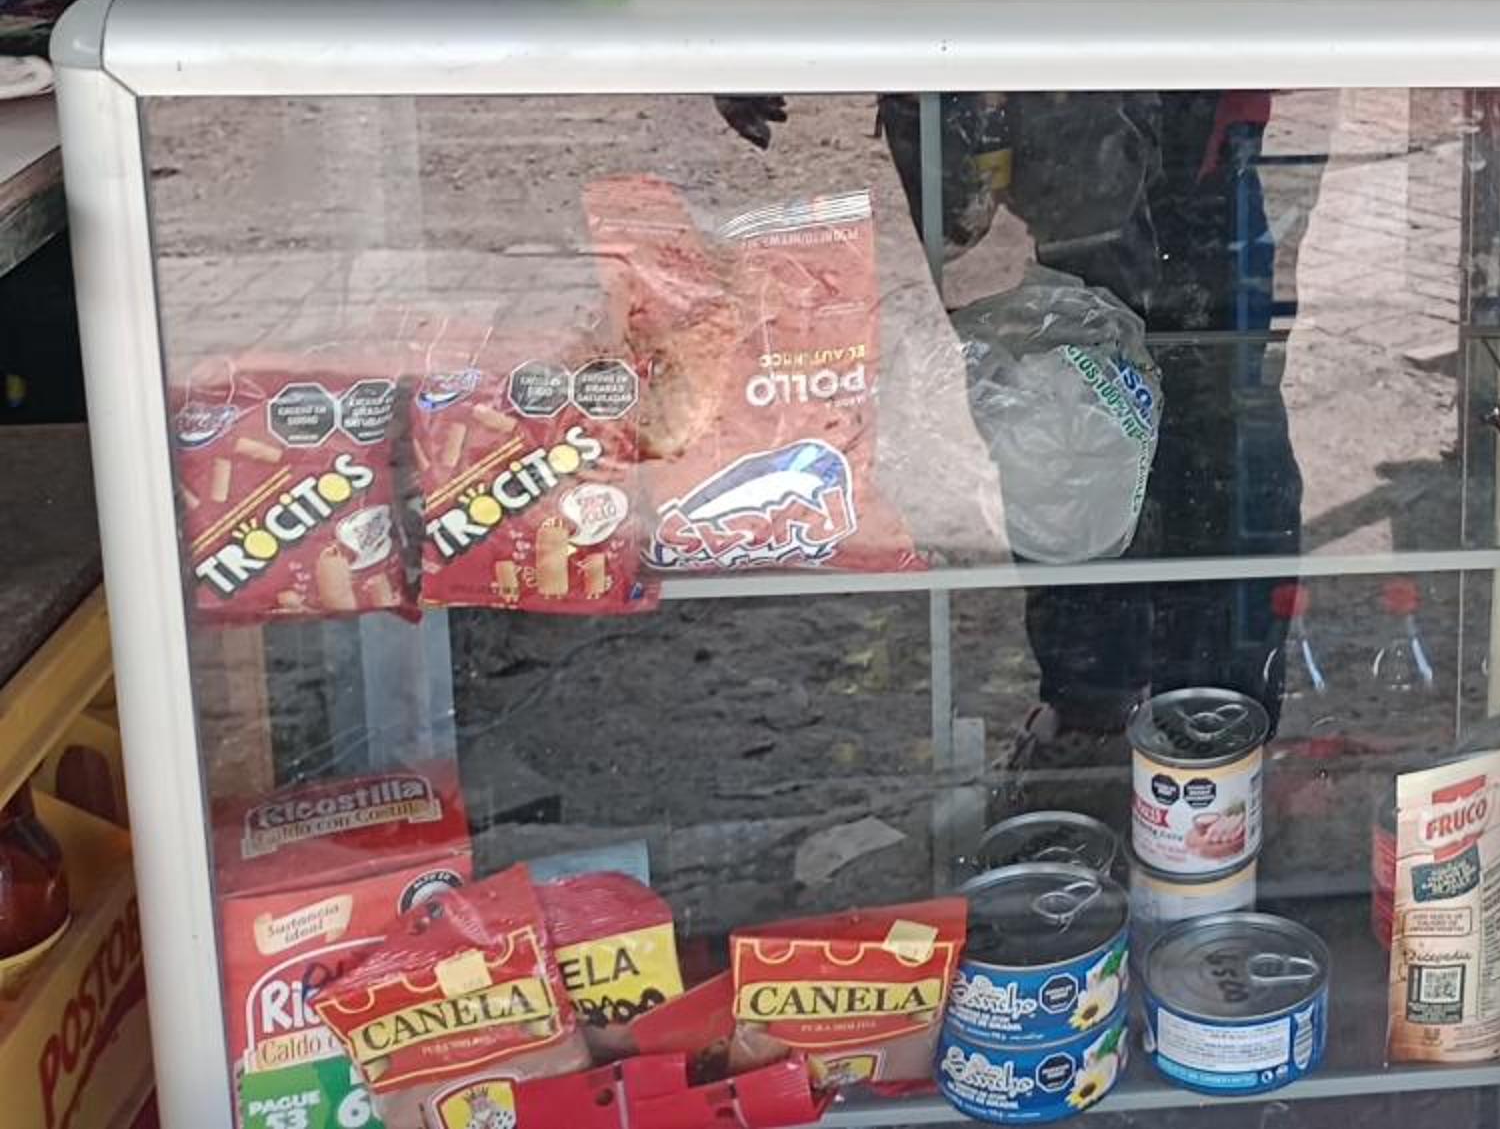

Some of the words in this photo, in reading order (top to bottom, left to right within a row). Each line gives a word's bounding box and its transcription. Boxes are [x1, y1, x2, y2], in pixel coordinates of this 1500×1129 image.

[746, 365, 866, 407] POLLO
[254, 779, 426, 831] Ricostilla
[1425, 800, 1488, 841] FRUCO
[556, 947, 641, 992] ELA
[261, 979, 326, 1032] Ric
[361, 984, 537, 1052] CANELA
[748, 985, 930, 1018] CANELA
[249, 1090, 321, 1118] PAGUE
